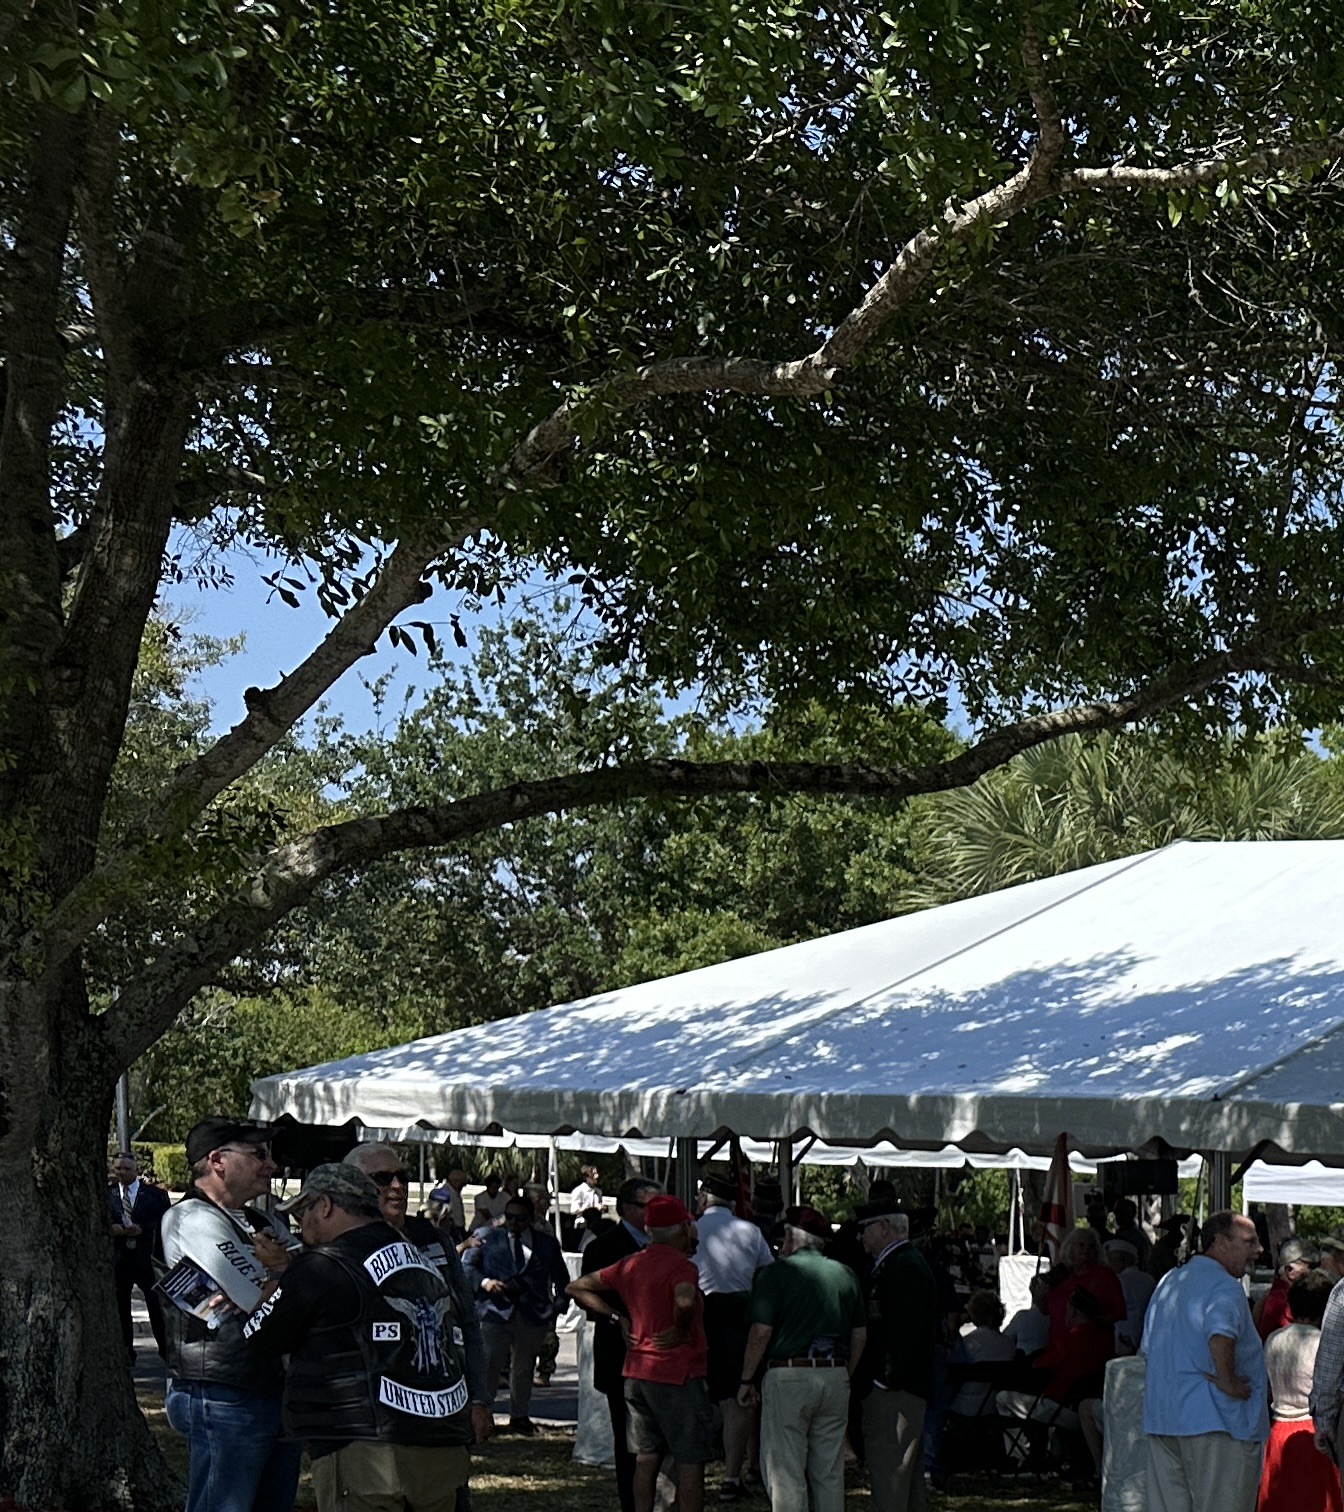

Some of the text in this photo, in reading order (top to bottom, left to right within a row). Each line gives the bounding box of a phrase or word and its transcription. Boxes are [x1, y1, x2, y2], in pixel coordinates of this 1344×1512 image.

[216, 1241, 257, 1277] BLUE
[370, 1245, 403, 1281] BLUE
[375, 1324, 399, 1339] PS
[383, 1380, 436, 1416] UNITED
